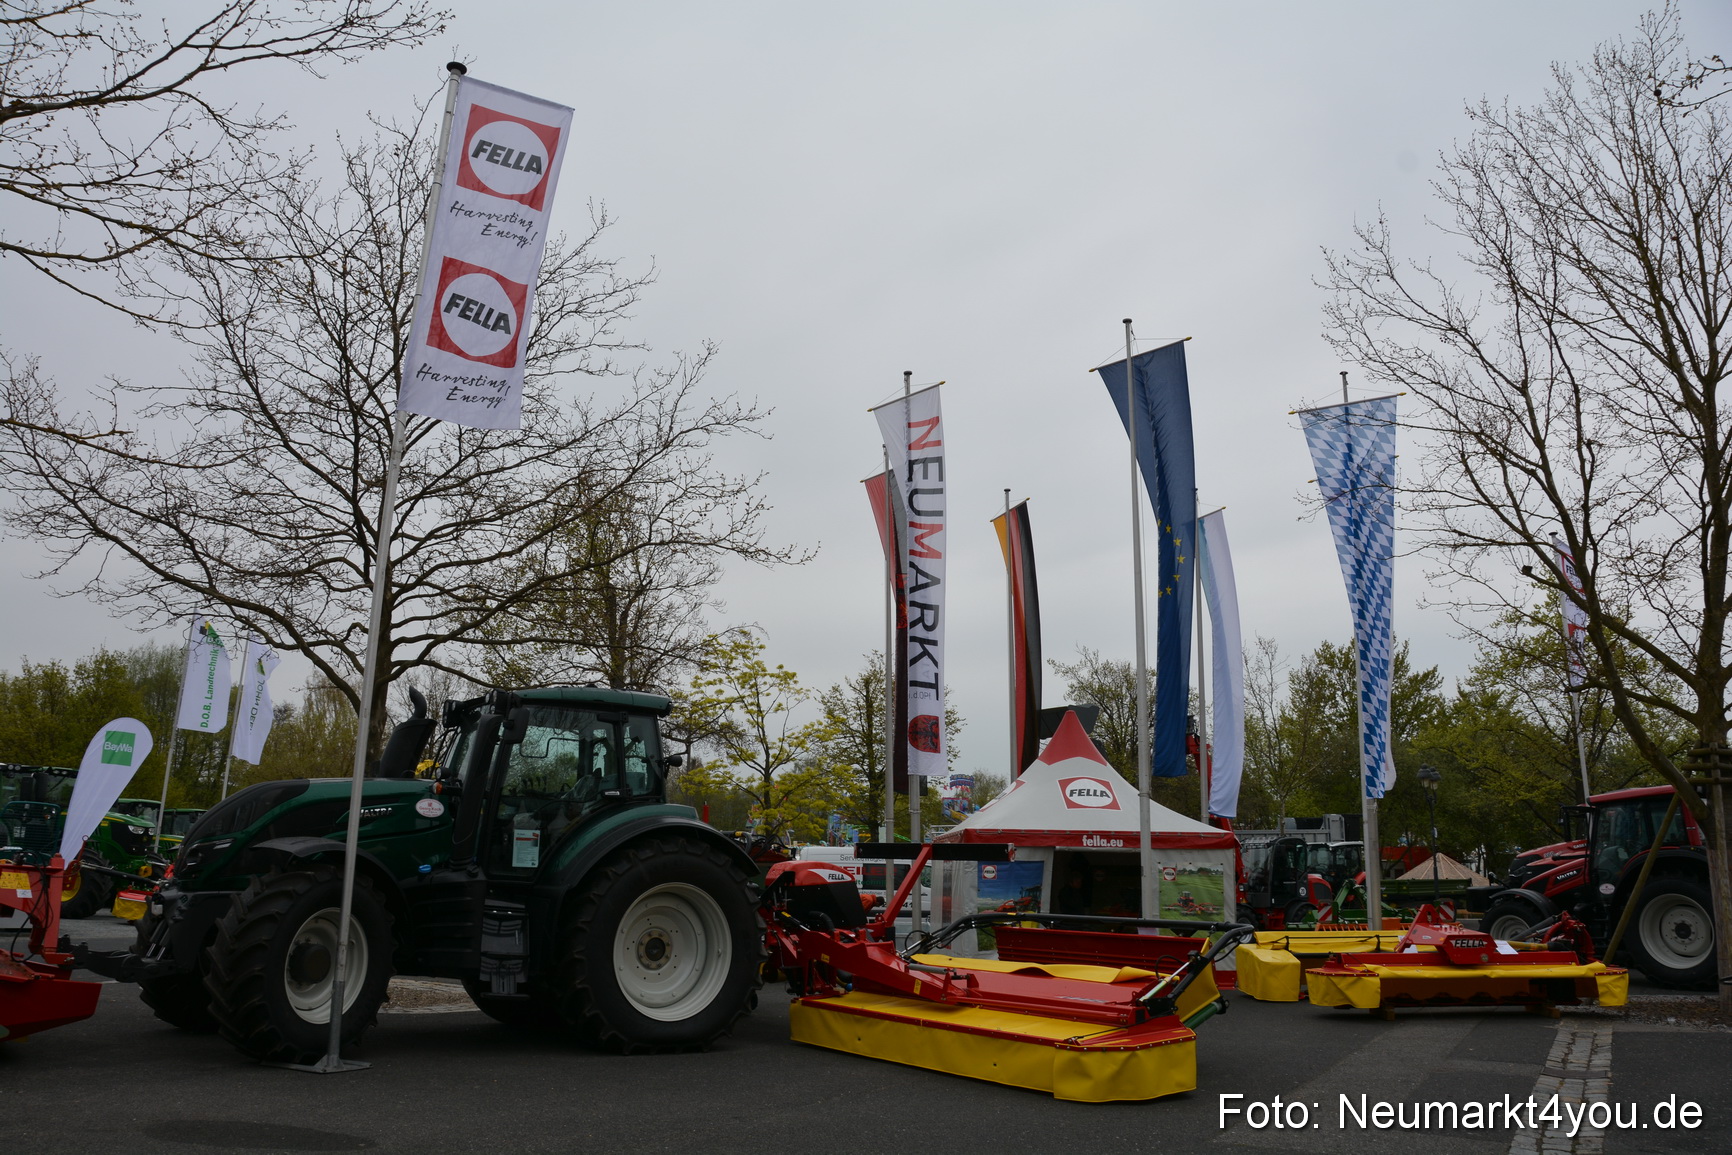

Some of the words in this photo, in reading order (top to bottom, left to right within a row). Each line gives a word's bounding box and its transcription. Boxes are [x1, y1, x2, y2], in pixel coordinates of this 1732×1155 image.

[471, 138, 543, 176] FELLA
[449, 200, 533, 232] Harvesting
[481, 223, 539, 249] Energy!
[443, 292, 512, 336] FELLA
[415, 362, 507, 393] Harvesting
[446, 386, 511, 409] Energy!
[907, 414, 942, 701] NEUMARKT
[204, 648, 219, 700] Landtechnik
[200, 702, 212, 728] D.O.B.
[104, 741, 133, 753] BayWa
[1069, 788, 1111, 799] FELLA
[1082, 834, 1124, 847] fella.eu
[828, 873, 845, 881] FELLA
[1454, 939, 1486, 948] FELLA
